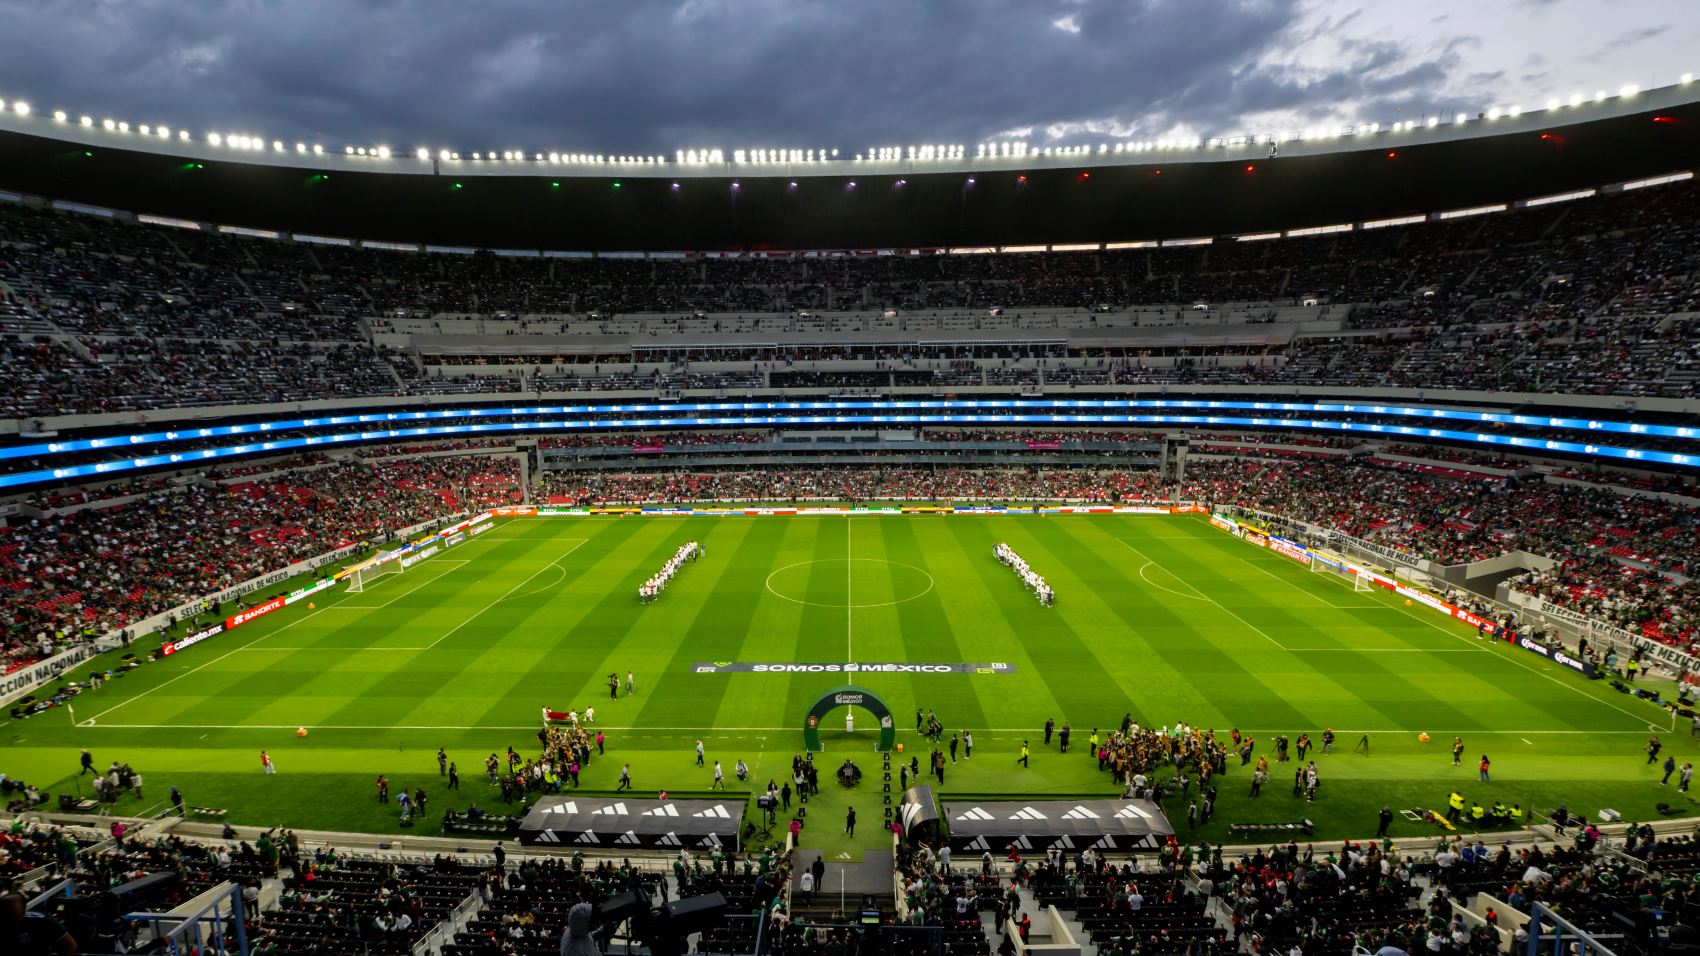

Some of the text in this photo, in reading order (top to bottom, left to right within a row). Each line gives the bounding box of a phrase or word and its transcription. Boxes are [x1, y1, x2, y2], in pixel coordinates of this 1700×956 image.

[1386, 549, 1395, 558] DE
[256, 580, 265, 589] DE
[244, 600, 282, 621] BANORTE
[173, 624, 223, 651] caliente.mx
[1521, 637, 1548, 656] Corona
[1643, 640, 1657, 654] DE
[752, 663, 952, 673] SOMOS MÉXICO
[1554, 652, 1584, 671] Corona
